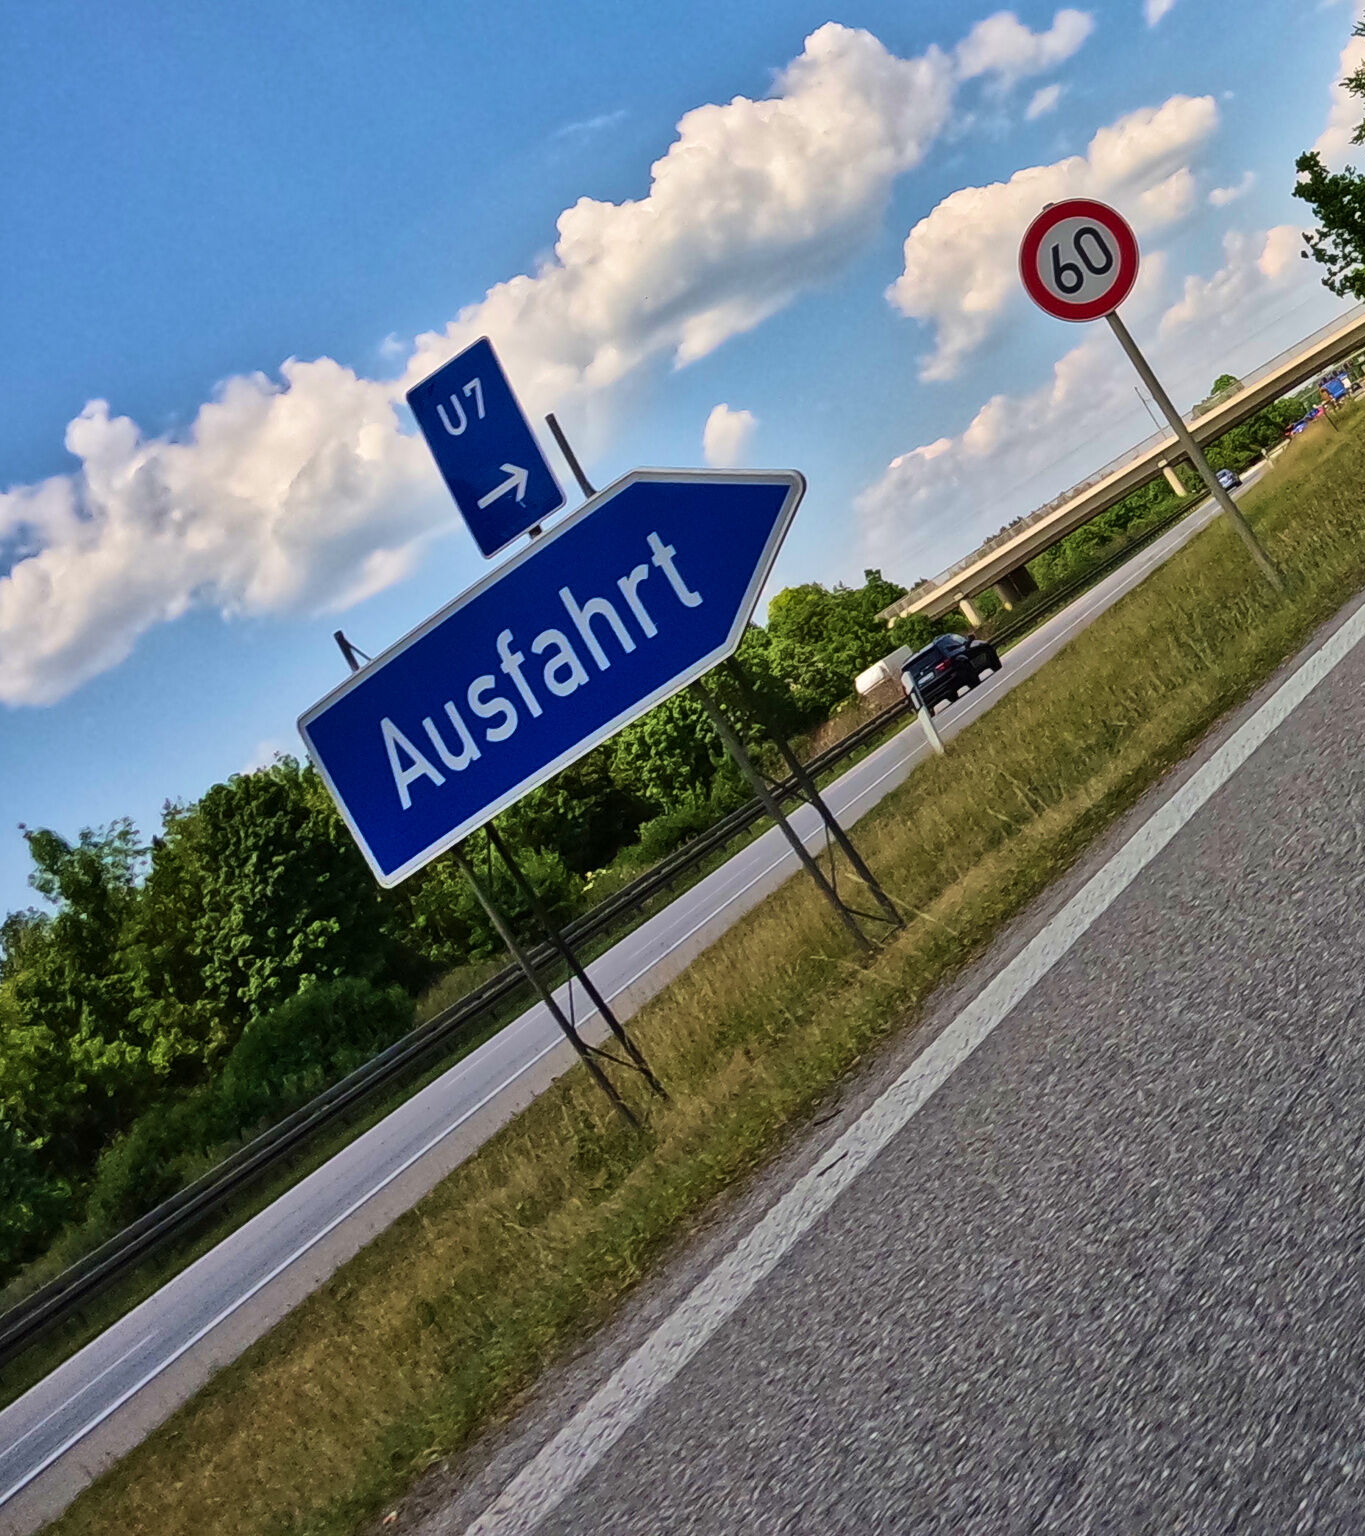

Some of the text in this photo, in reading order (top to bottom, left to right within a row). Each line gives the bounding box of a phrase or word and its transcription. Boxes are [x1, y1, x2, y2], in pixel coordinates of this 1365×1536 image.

[1051, 226, 1114, 295] 60
[436, 377, 486, 436] U7
[380, 530, 704, 811] Ausfahrt
